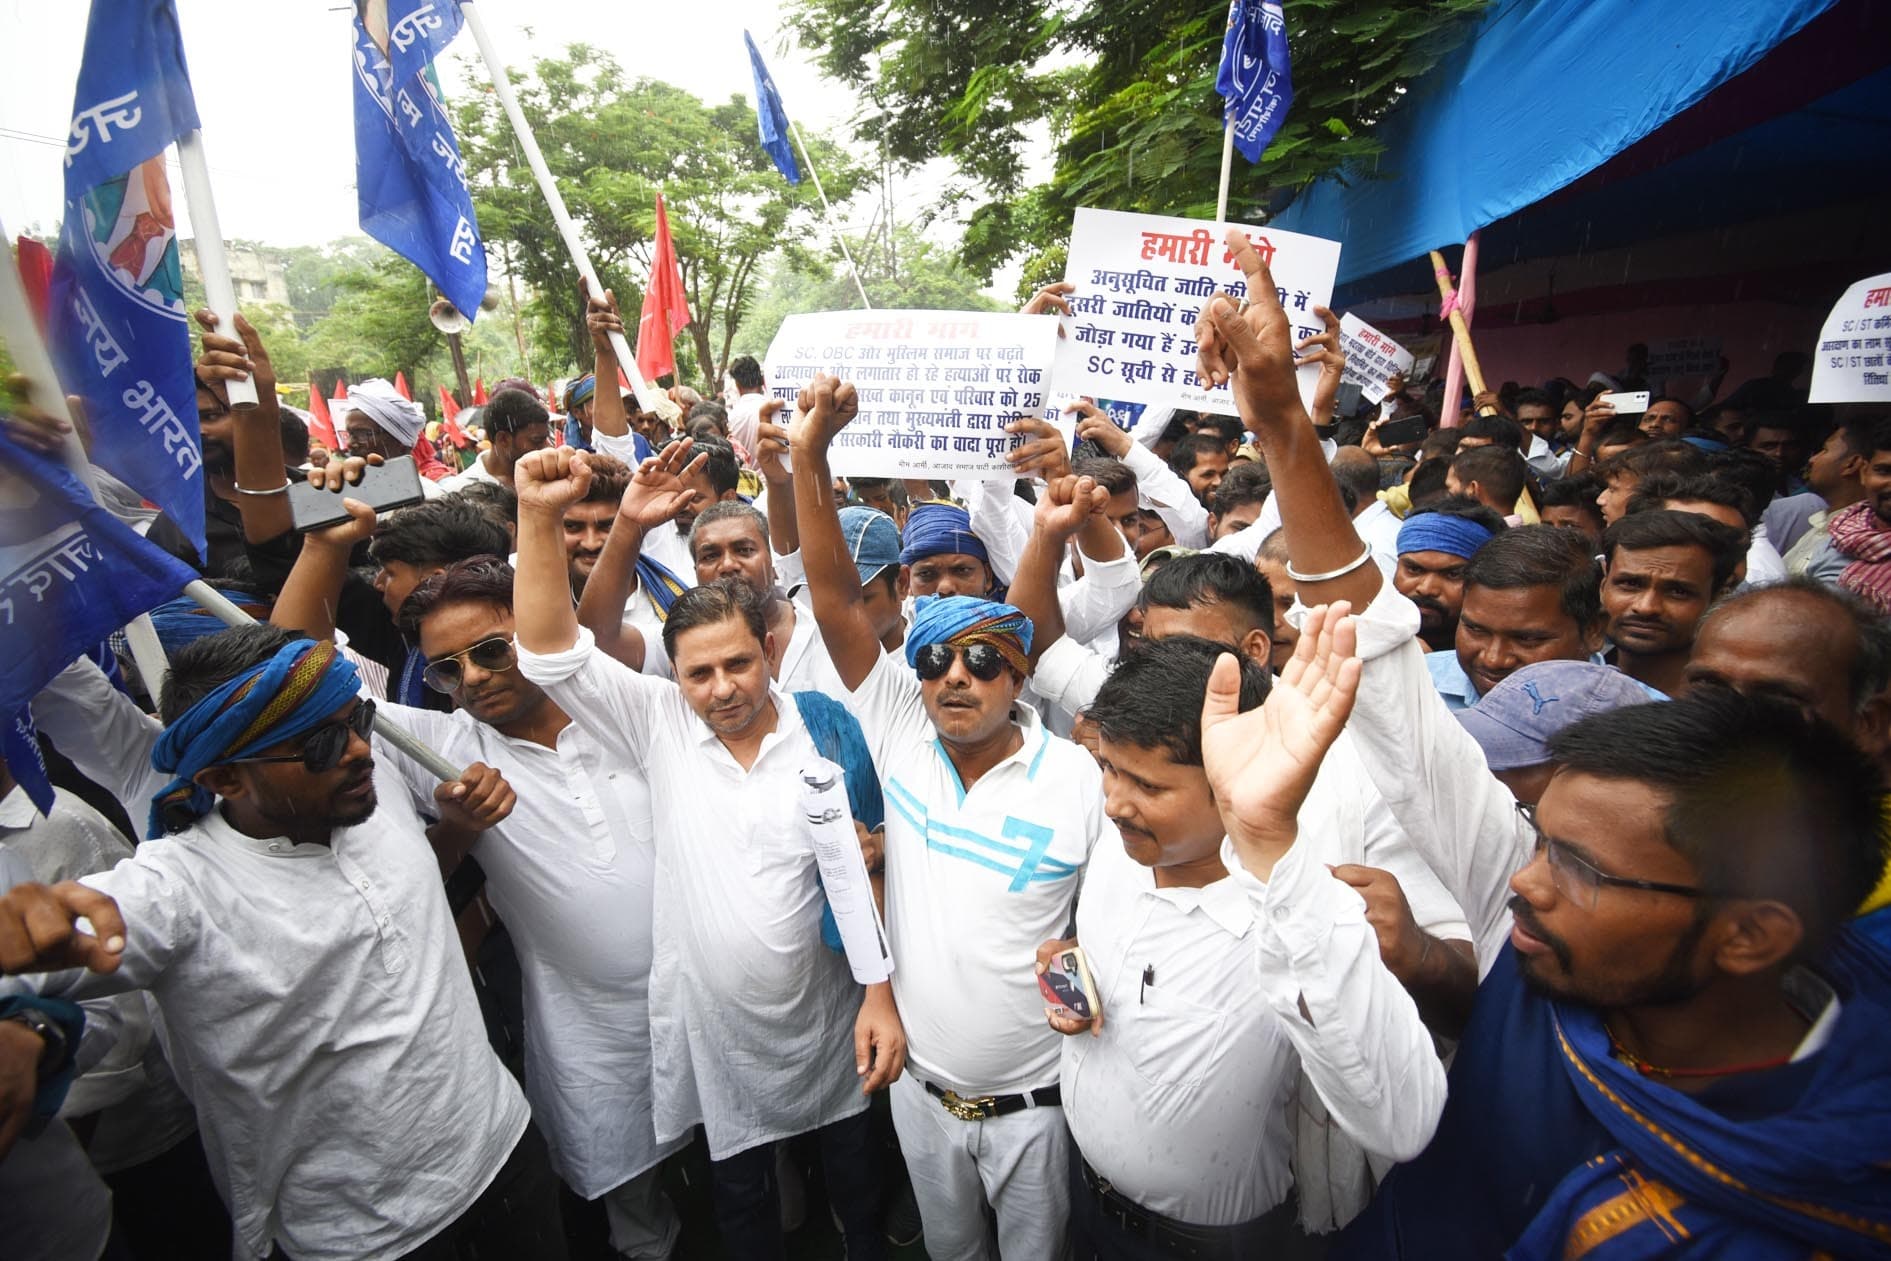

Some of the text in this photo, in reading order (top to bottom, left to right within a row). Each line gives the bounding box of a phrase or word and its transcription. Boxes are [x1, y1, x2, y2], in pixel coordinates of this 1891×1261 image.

[1141, 229, 1215, 266] हमारी
[1091, 269, 1169, 294] अनुसूचित
[1174, 276, 1218, 298] जाति
[1294, 290, 1311, 311] में
[1864, 286, 1891, 309] हमा
[1065, 294, 1107, 317] दूसरी
[1112, 299, 1177, 323] जातियों
[1075, 323, 1115, 349] जोड़ा
[1121, 331, 1156, 351] गया
[1161, 332, 1177, 353] हैं
[822, 346, 854, 360] OBC
[933, 347, 971, 360] समाज
[976, 347, 993, 360] पर
[74, 287, 201, 480] जय भारत
[856, 366, 901, 380] लगातार
[906, 363, 920, 380] हो
[925, 363, 939, 381] रहे
[996, 368, 1012, 383] पर
[1016, 364, 1043, 384] रोक
[1087, 355, 1115, 375] SC
[1121, 359, 1156, 383] सूची
[1161, 363, 1177, 383] से
[889, 388, 924, 408] कानून
[954, 385, 995, 406] परिवार
[1000, 387, 1018, 407] को
[1022, 392, 1041, 408] 25
[876, 411, 901, 425] तथा
[967, 413, 992, 429] द्वारा
[840, 429, 883, 448] सरकारी
[888, 429, 925, 450] नौकरी
[930, 435, 948, 451] का
[953, 436, 981, 452] वादा
[986, 437, 1006, 458] पूरा
[1001, 815, 1055, 893] 7
